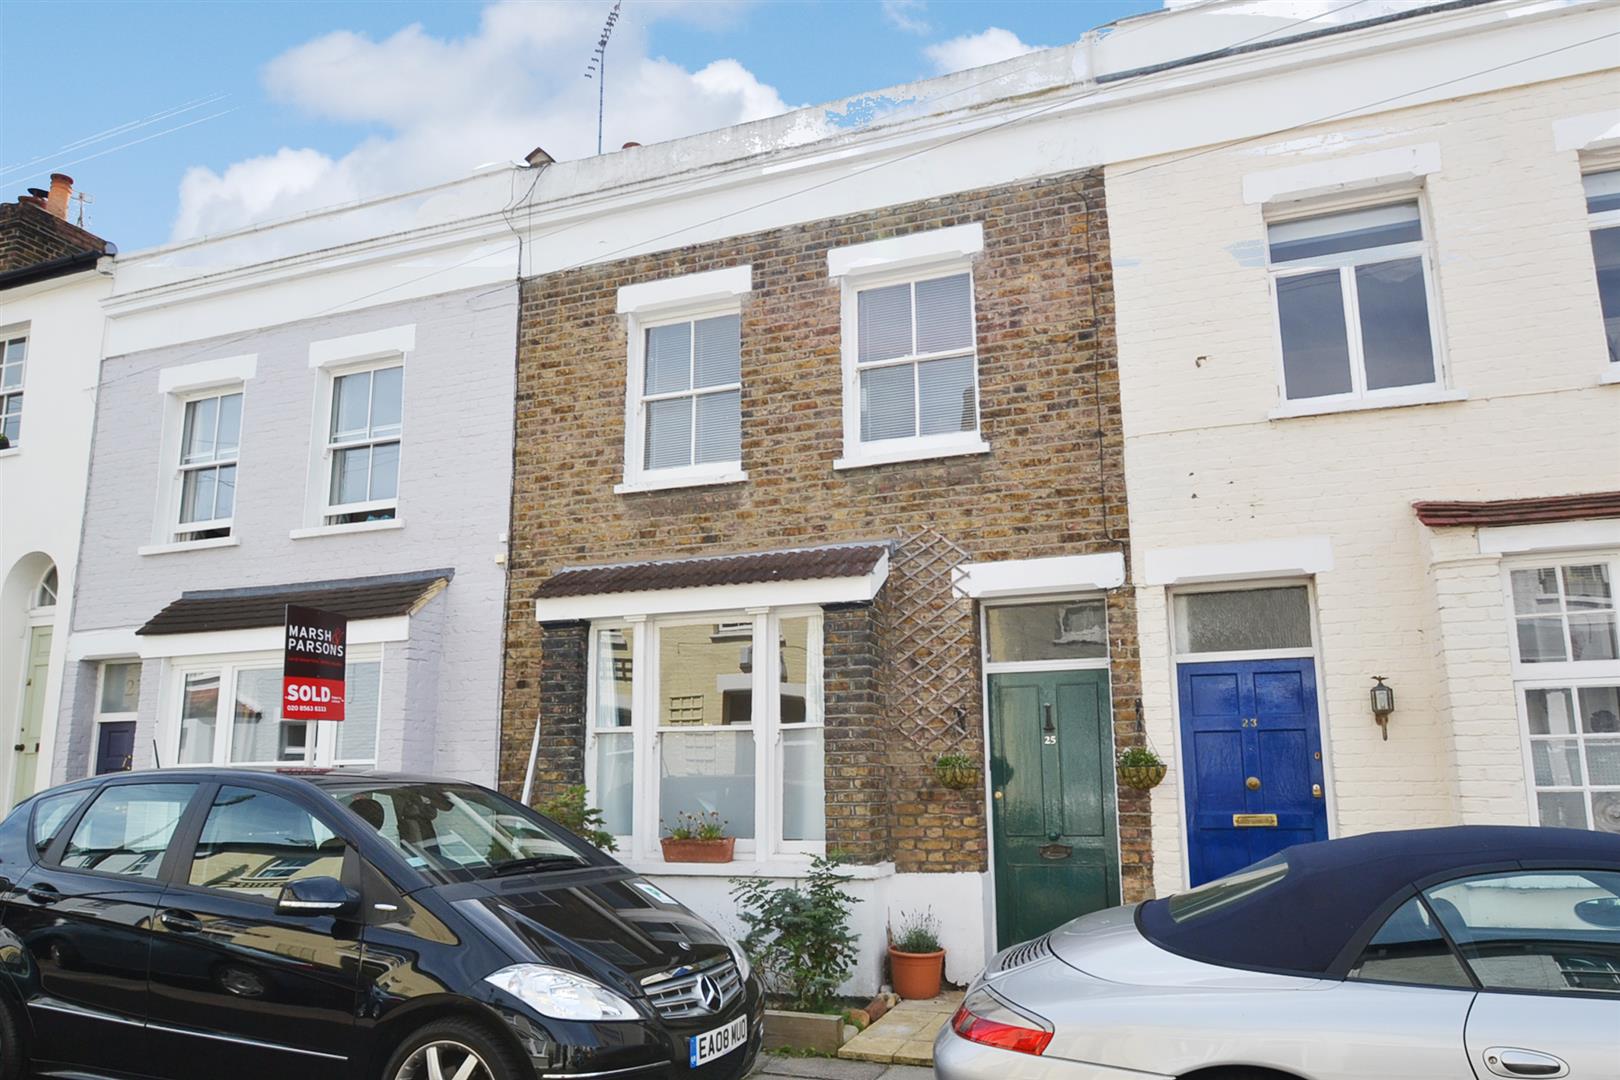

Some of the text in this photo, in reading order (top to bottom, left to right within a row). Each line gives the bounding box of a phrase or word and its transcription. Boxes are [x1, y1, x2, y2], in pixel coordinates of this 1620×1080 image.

[288, 624, 332, 642] MARSH
[288, 638, 344, 657] PARSONS
[287, 684, 331, 703] SOLD
[1242, 718, 1258, 729] 23
[1043, 735, 1057, 745] 25
[699, 1028, 730, 1060] EA08
